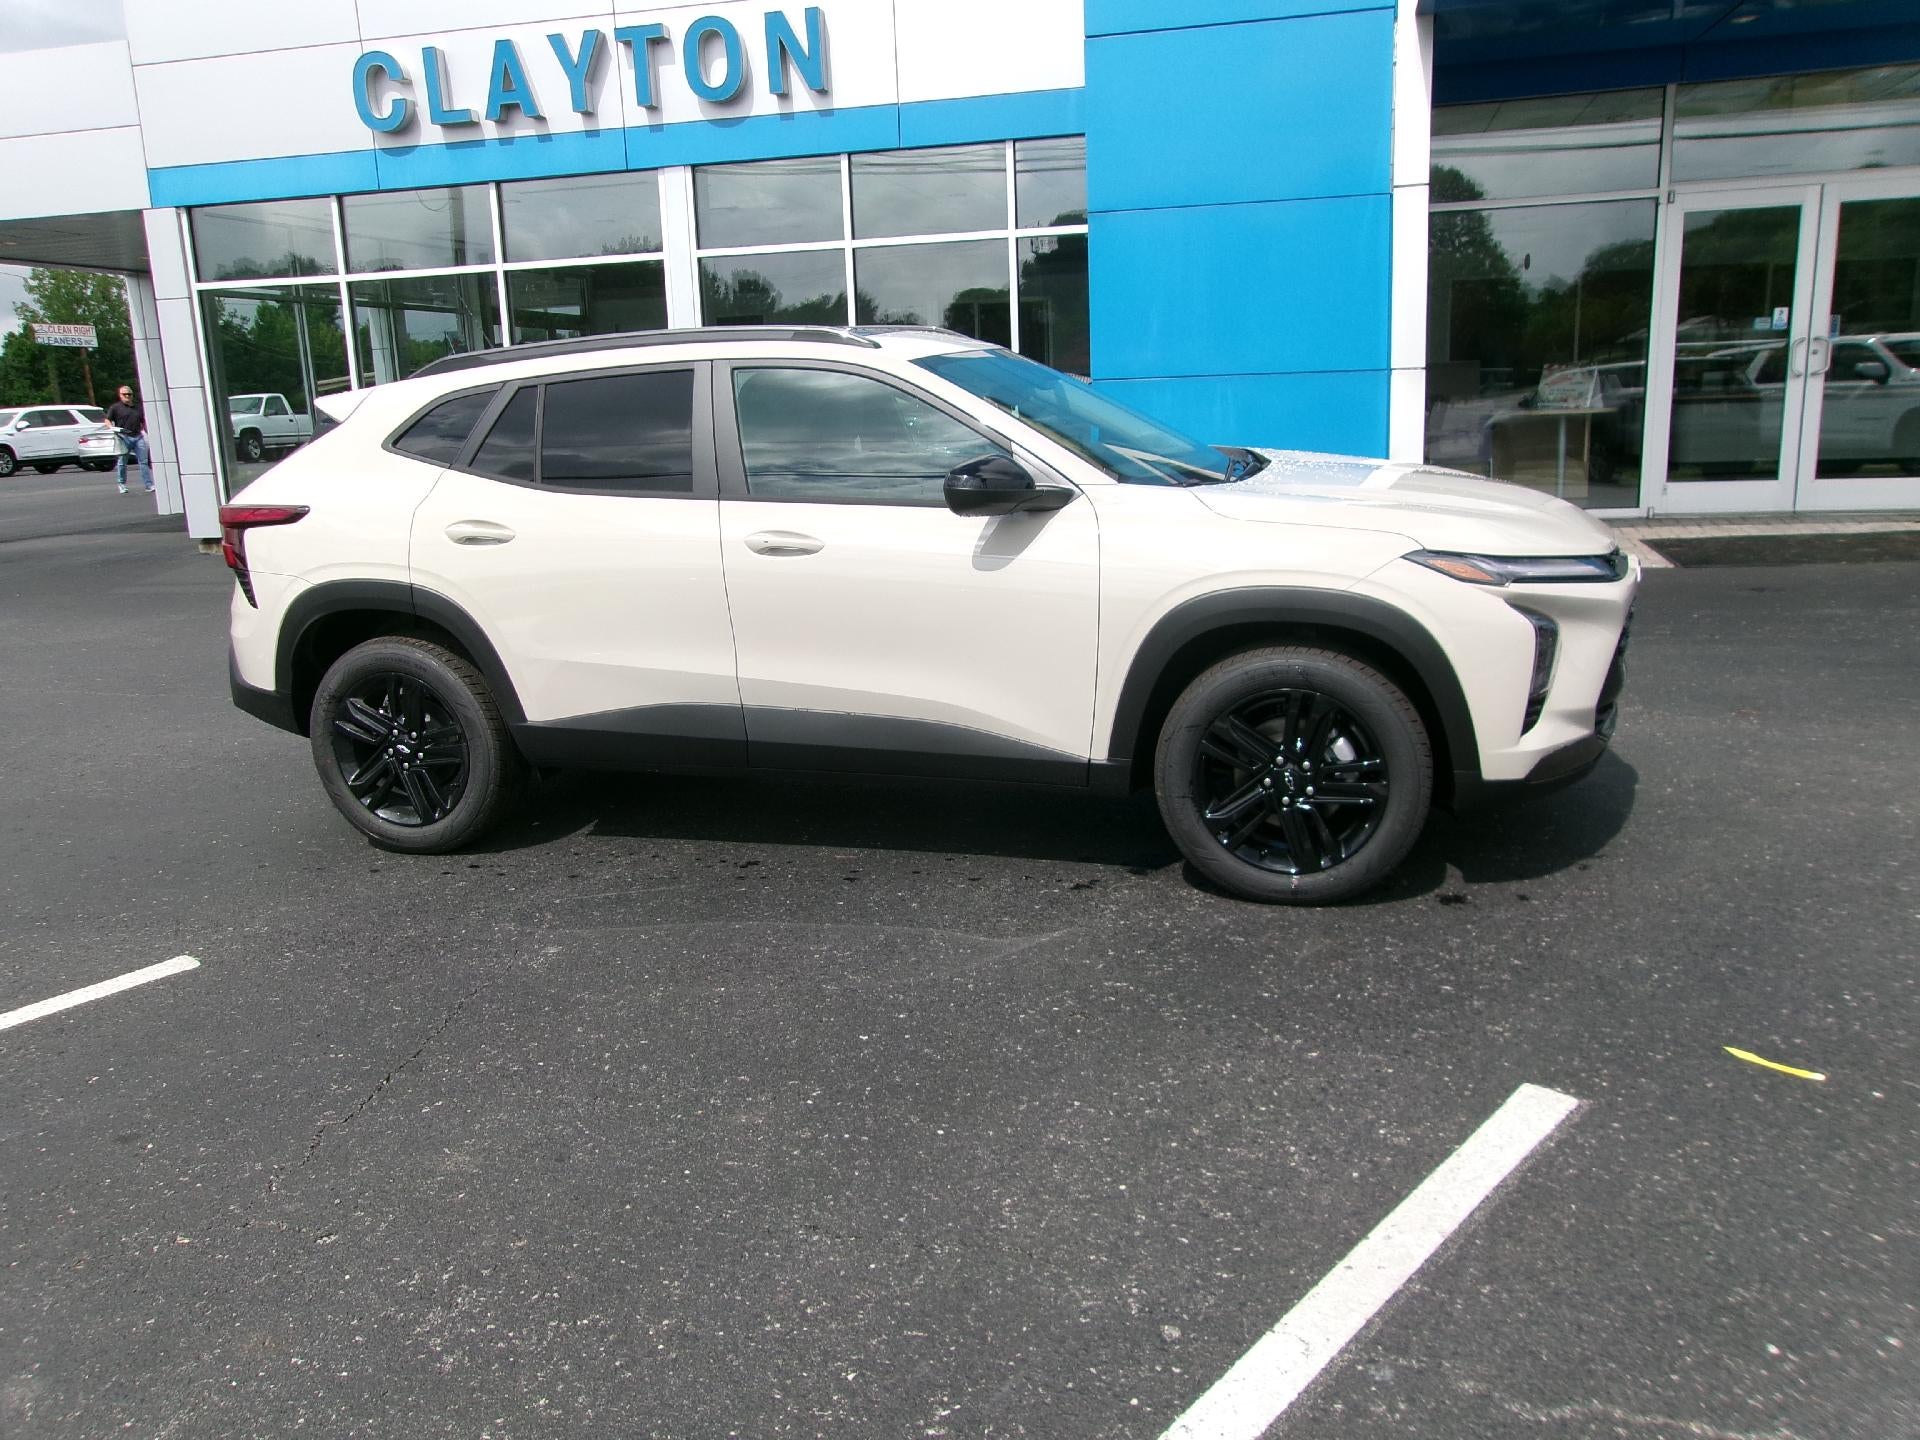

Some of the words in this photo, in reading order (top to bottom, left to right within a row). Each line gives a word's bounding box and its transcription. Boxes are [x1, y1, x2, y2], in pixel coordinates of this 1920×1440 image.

[353, 6, 828, 132] CLAYTON
[48, 325, 72, 334] CLEAN
[73, 326, 95, 335] RIGHT
[36, 336, 83, 345] CLEANERS
